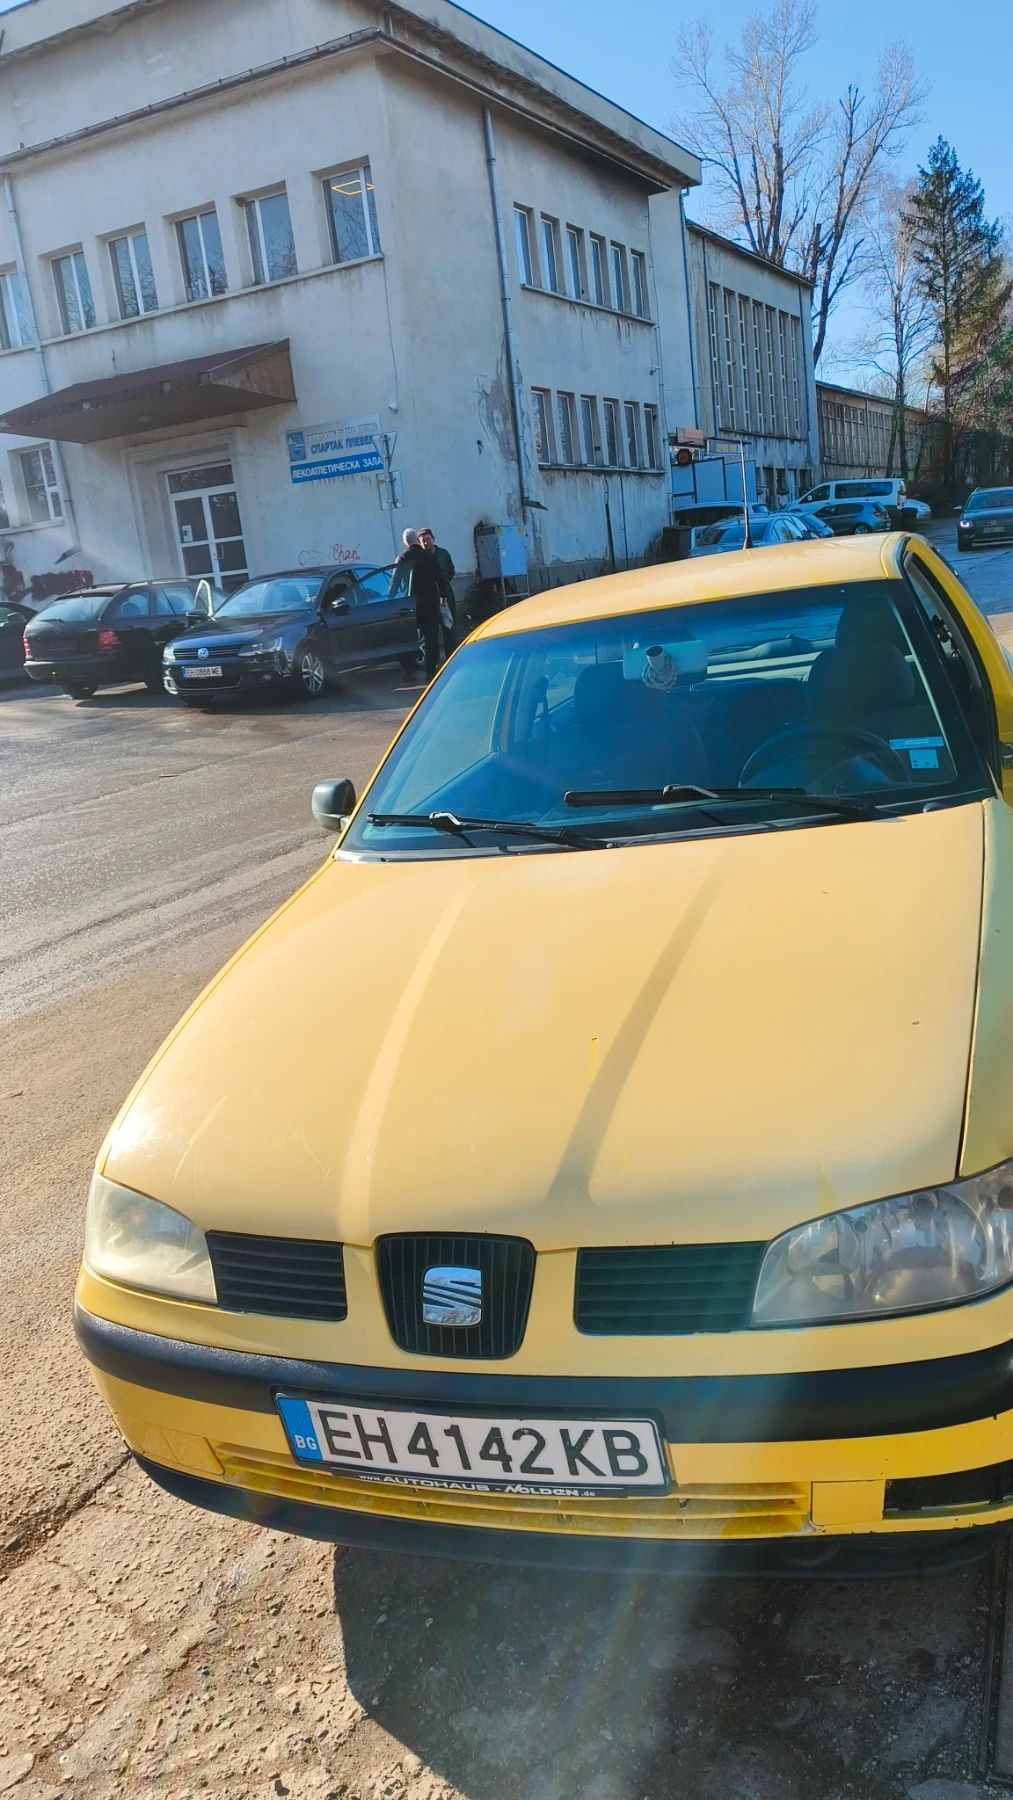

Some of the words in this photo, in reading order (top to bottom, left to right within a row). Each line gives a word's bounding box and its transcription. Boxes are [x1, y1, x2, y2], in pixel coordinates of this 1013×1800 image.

[311, 439, 343, 454] СПАРТАК
[293, 460, 360, 479] ЛЕКОАТЛЕТИЧЕСКА
[363, 457, 383, 467] ЗАЛА
[294, 1435, 317, 1450] BG
